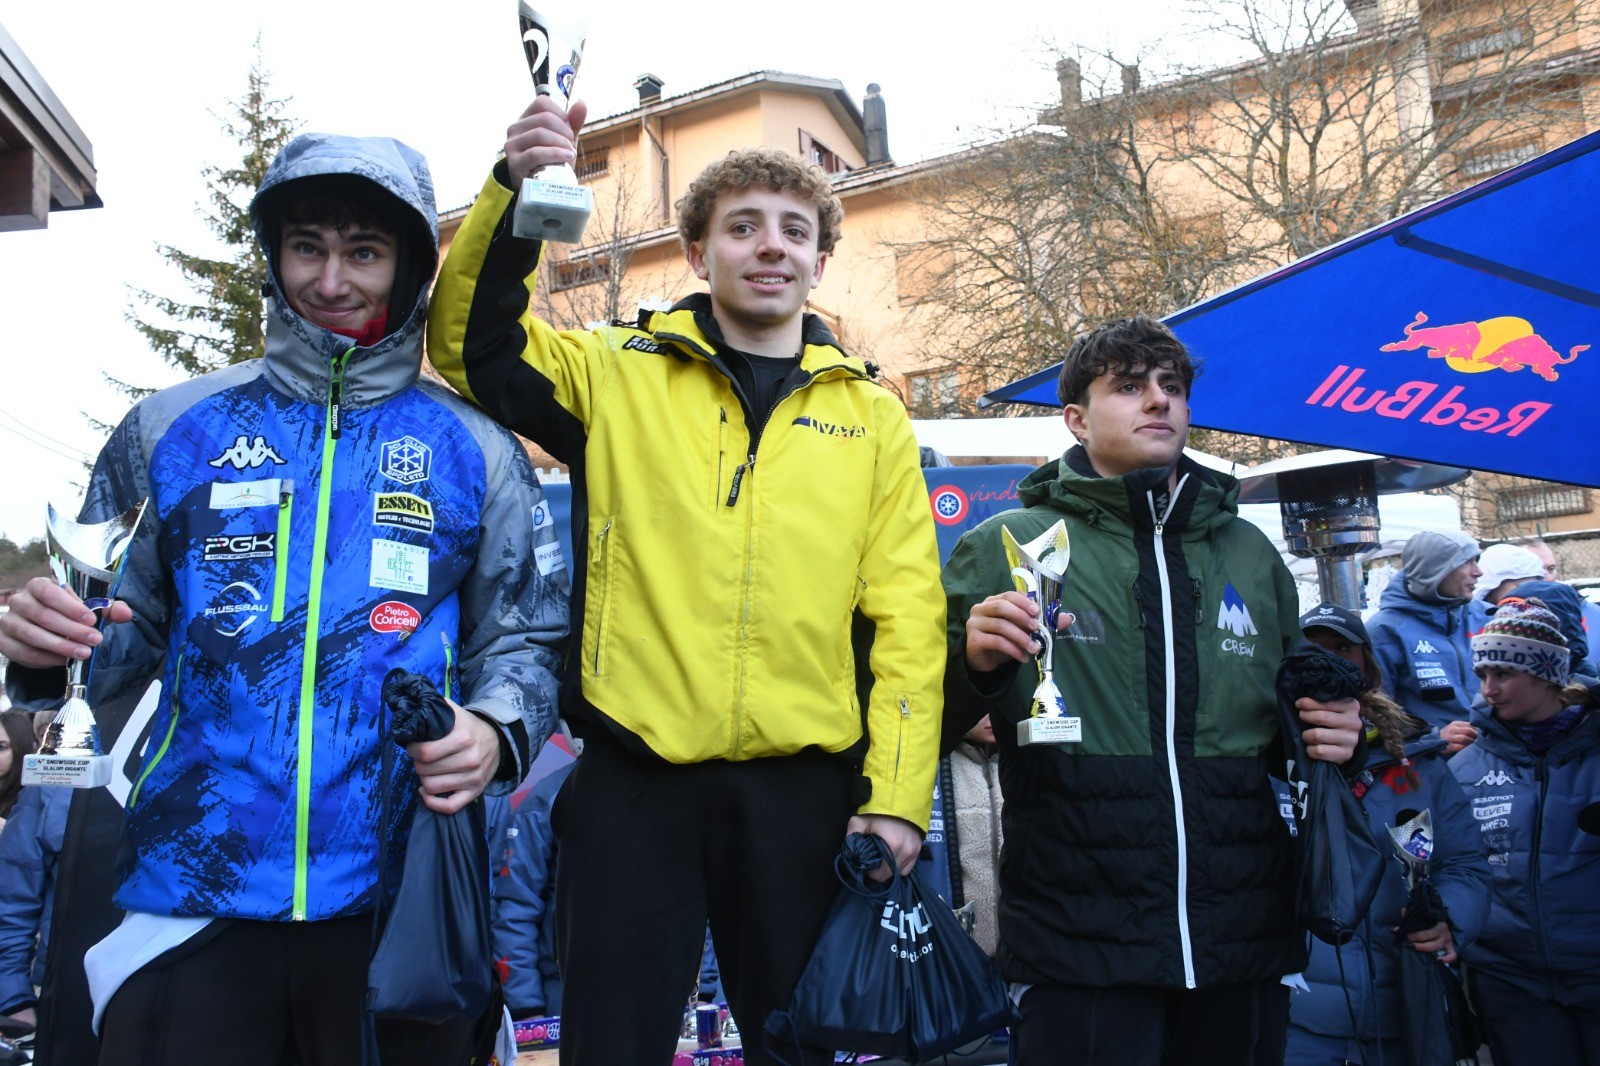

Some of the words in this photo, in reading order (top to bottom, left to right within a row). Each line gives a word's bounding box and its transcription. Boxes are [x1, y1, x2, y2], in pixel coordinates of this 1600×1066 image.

[386, 469, 425, 481] SPOLETO
[377, 496, 430, 516] ESSETI
[204, 534, 274, 553] PGK
[537, 548, 562, 561] INVES
[204, 603, 269, 616] FLUSSBAU
[384, 605, 410, 617] Pietro
[374, 613, 418, 628] Coricelli
[1221, 638, 1256, 658] CREW
[1477, 649, 1527, 666] POLO
[1473, 794, 1514, 804] salomon
[1475, 805, 1509, 818] LEVEL
